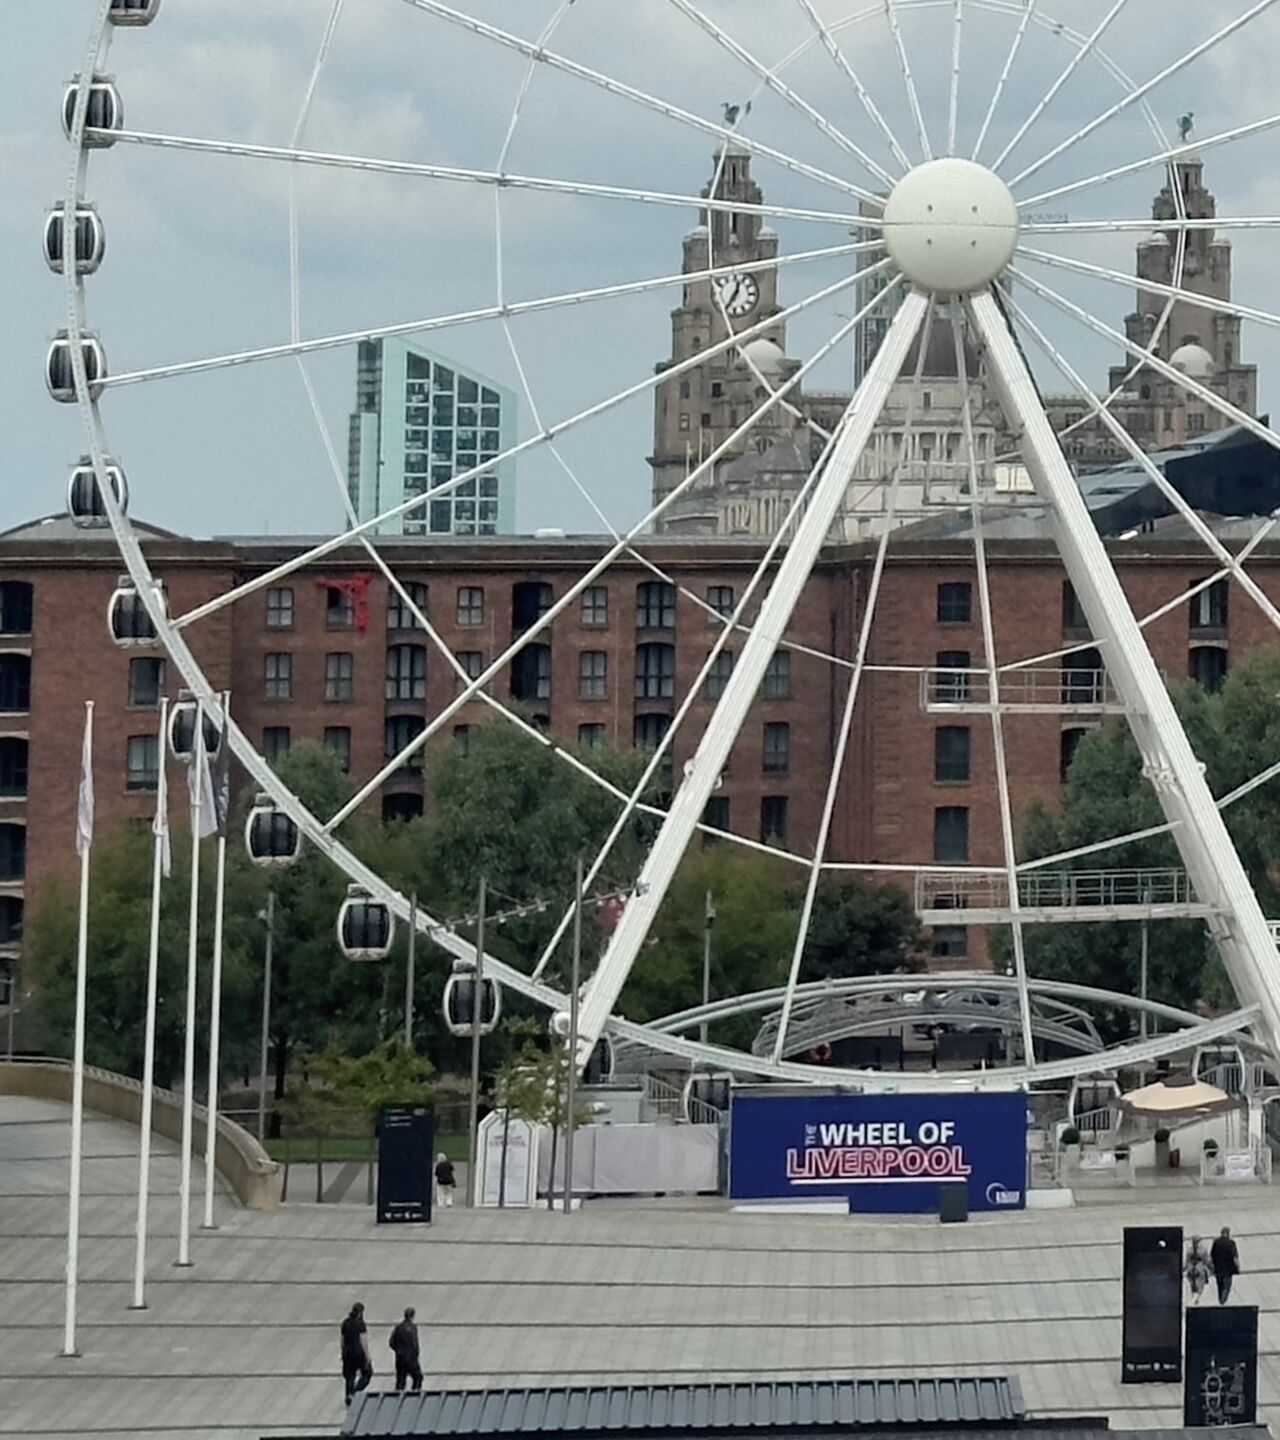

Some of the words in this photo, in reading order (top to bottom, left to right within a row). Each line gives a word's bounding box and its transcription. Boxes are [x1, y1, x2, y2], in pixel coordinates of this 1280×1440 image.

[819, 1122, 912, 1146] WHEEL
[918, 1121, 955, 1145] OF
[786, 1145, 971, 1178] LIVERPOOL
